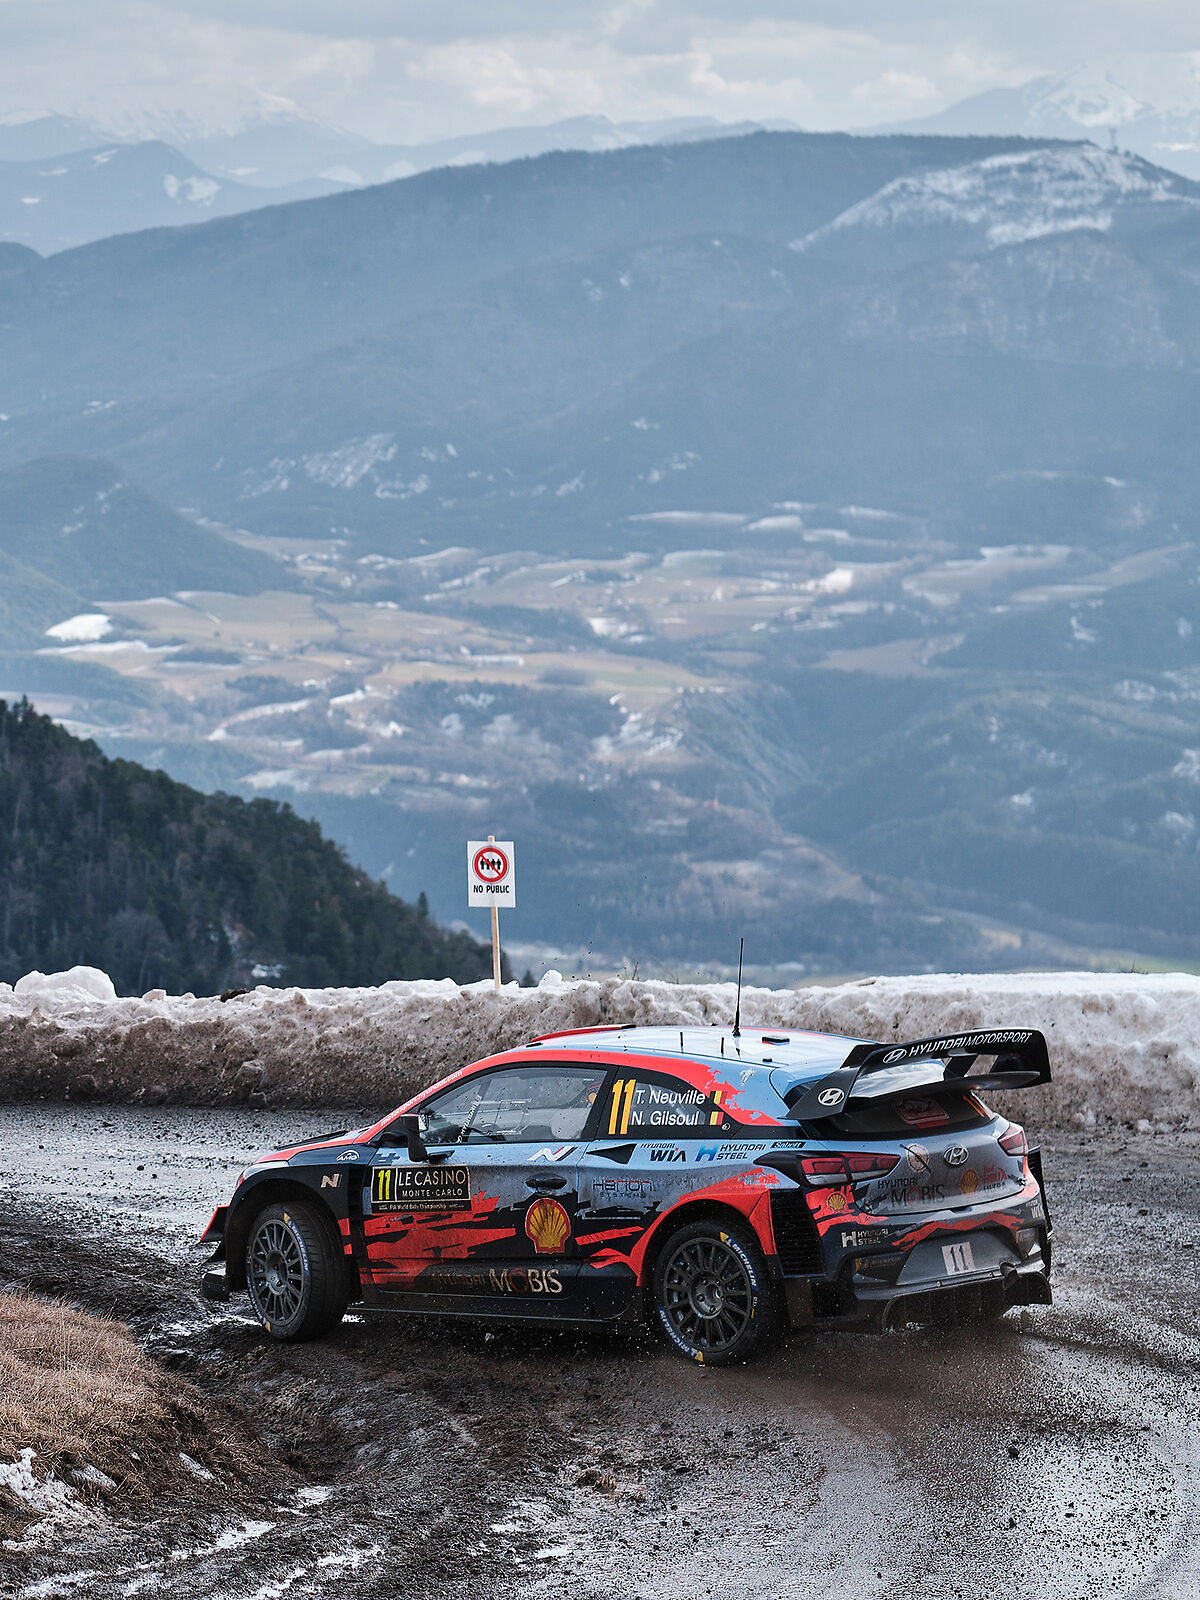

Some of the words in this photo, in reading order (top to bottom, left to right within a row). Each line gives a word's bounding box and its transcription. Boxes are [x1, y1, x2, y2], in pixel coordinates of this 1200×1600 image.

[473, 885, 483, 893] NO
[486, 885, 509, 893] PUBLIC
[635, 1089, 646, 1104] T.
[649, 1089, 705, 1104] Neuville
[608, 1079, 636, 1135] 11
[631, 1111, 646, 1126] N.
[650, 1111, 699, 1126] Gilsoul
[649, 1147, 686, 1162] WIA
[719, 1143, 766, 1152] HYUNDAI
[716, 1152, 748, 1160] STEEL
[378, 1169, 391, 1200] 11
[399, 1172, 412, 1186] LE
[414, 1169, 466, 1186] CASINO
[877, 1177, 918, 1189] HYUNDAI
[891, 1184, 945, 1206] MOBIS
[732, 1242, 757, 1287] MICHELIN
[949, 1244, 969, 1272] 11
[488, 1267, 563, 1293] MOBIS
